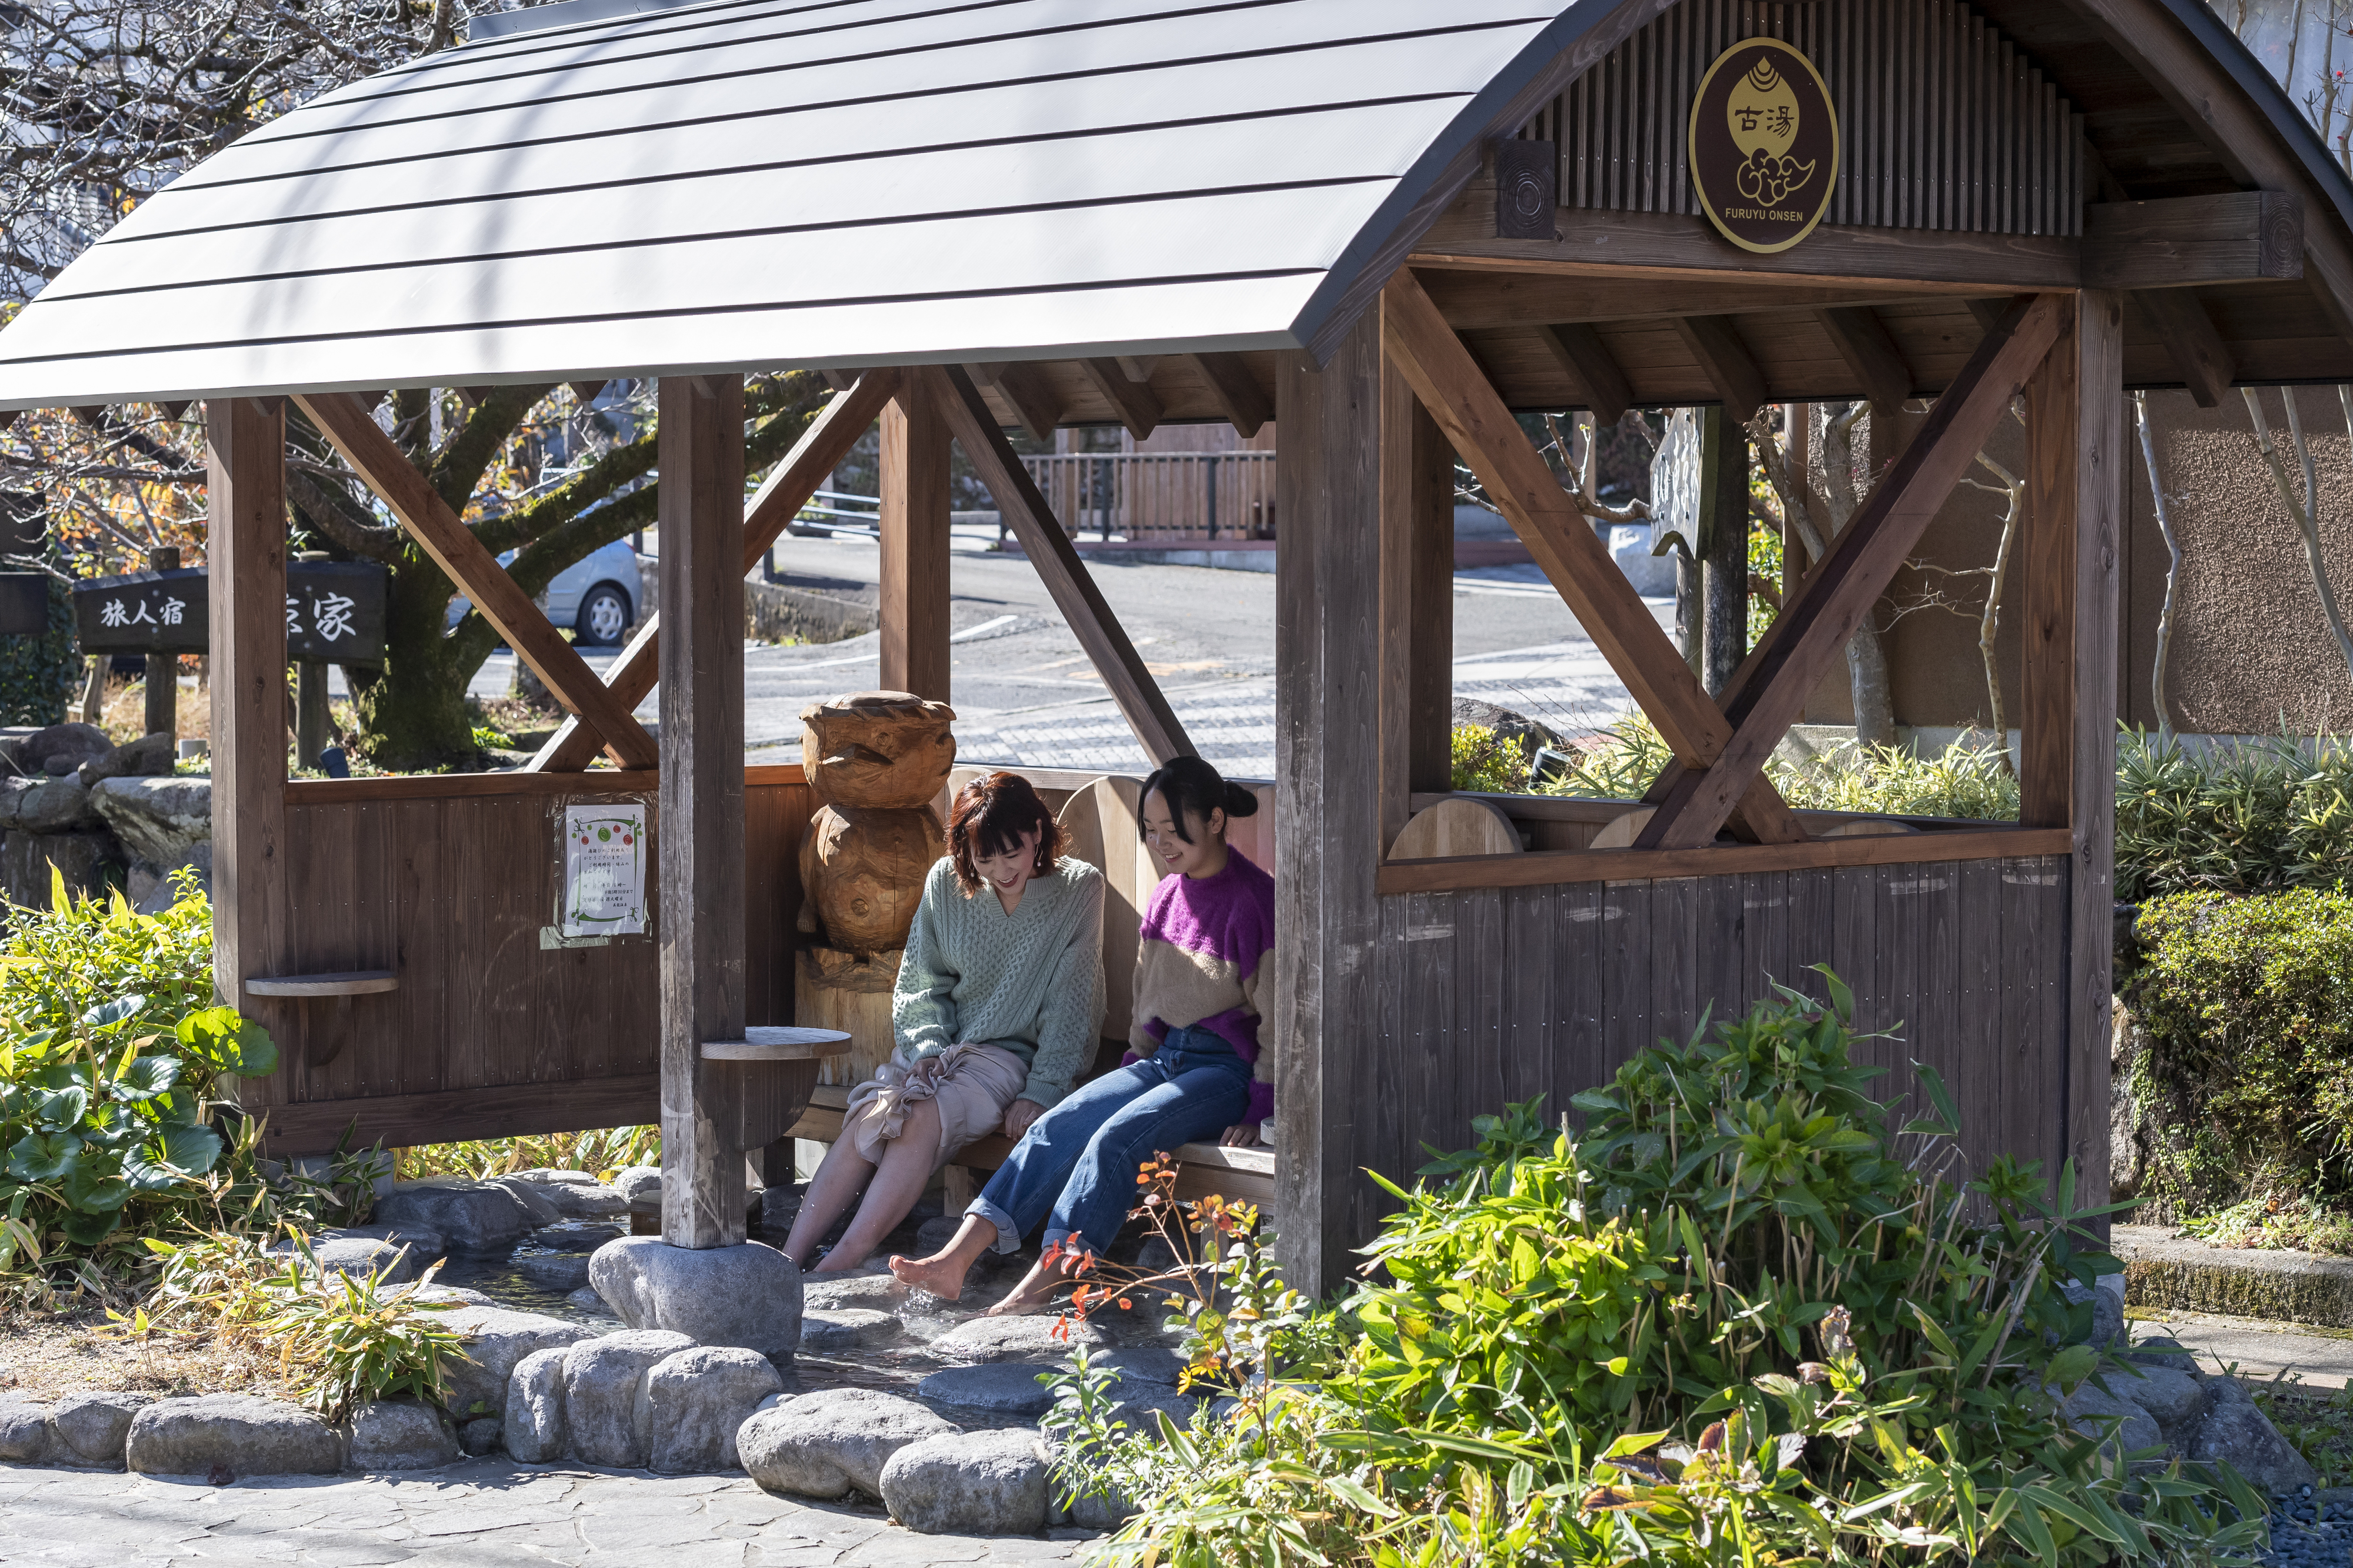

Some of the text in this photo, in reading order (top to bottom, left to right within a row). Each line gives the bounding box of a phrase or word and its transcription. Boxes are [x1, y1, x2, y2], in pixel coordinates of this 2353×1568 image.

[1735, 106, 1795, 138] 古湯
[1725, 208, 1803, 222] FURUYU ONSEN
[99, 595, 186, 627] 旅人宿
